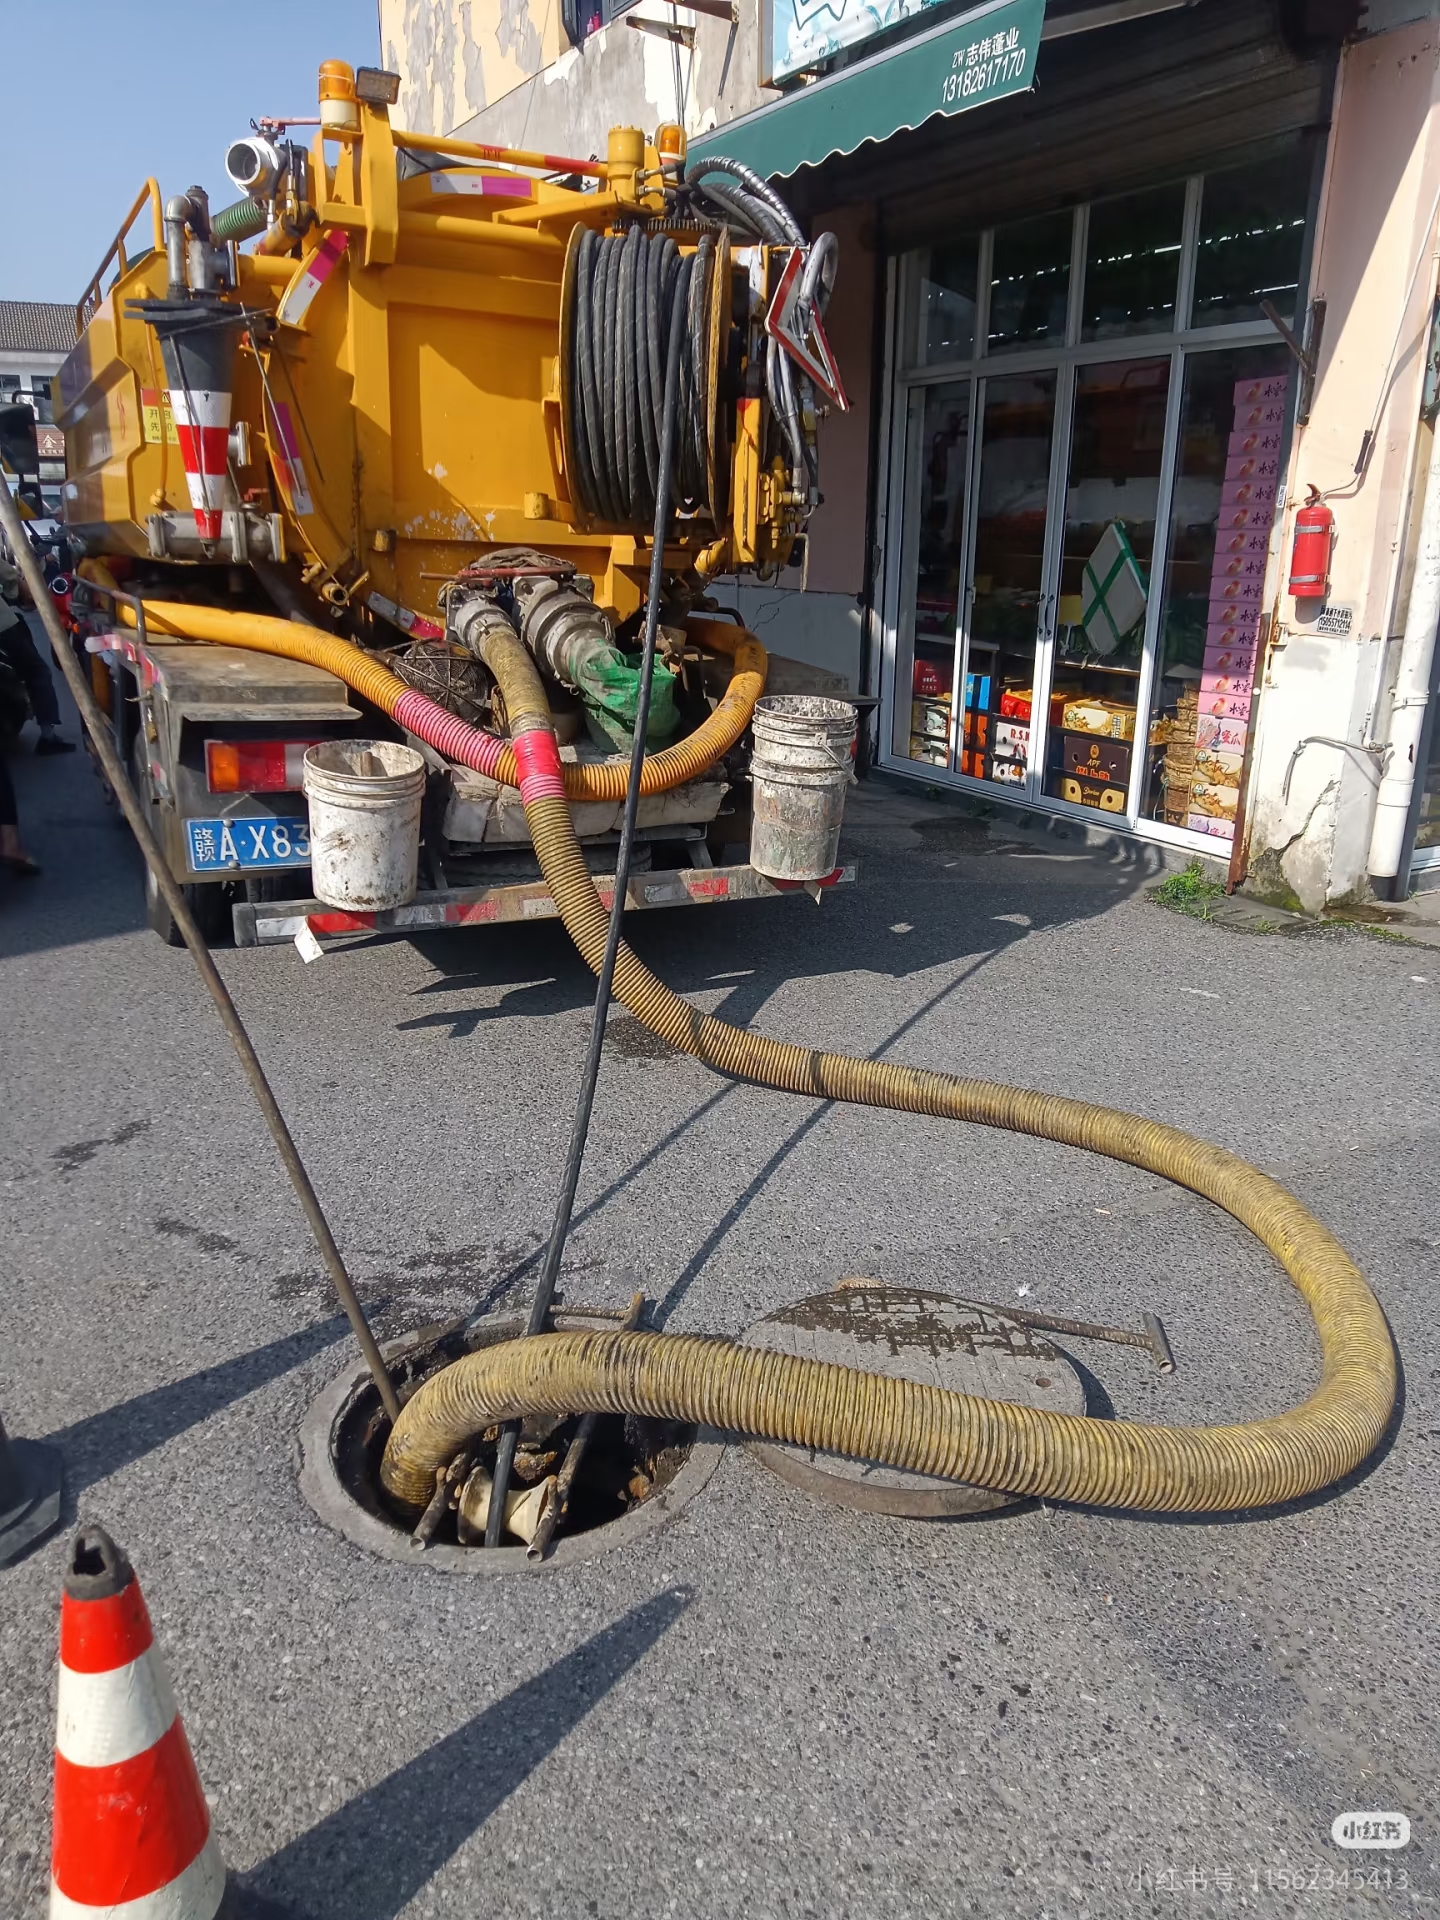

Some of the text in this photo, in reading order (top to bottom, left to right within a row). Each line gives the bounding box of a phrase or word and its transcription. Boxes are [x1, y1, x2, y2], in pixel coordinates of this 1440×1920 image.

[942, 48, 1026, 104] 13182617170
[1264, 382, 1287, 397] 水蜜
[1255, 486, 1275, 500] 水蜜
[1252, 511, 1272, 525] 水蜜
[1249, 536, 1269, 550] 水蜜
[1246, 560, 1266, 575] 水蜜
[1243, 584, 1263, 598] 水蜜
[1240, 609, 1260, 623] 水蜜
[1239, 632, 1258, 645] 水蜜
[1236, 656, 1255, 670] 水蜜
[1233, 680, 1252, 693] 水蜜
[1229, 703, 1250, 716] 水蜜
